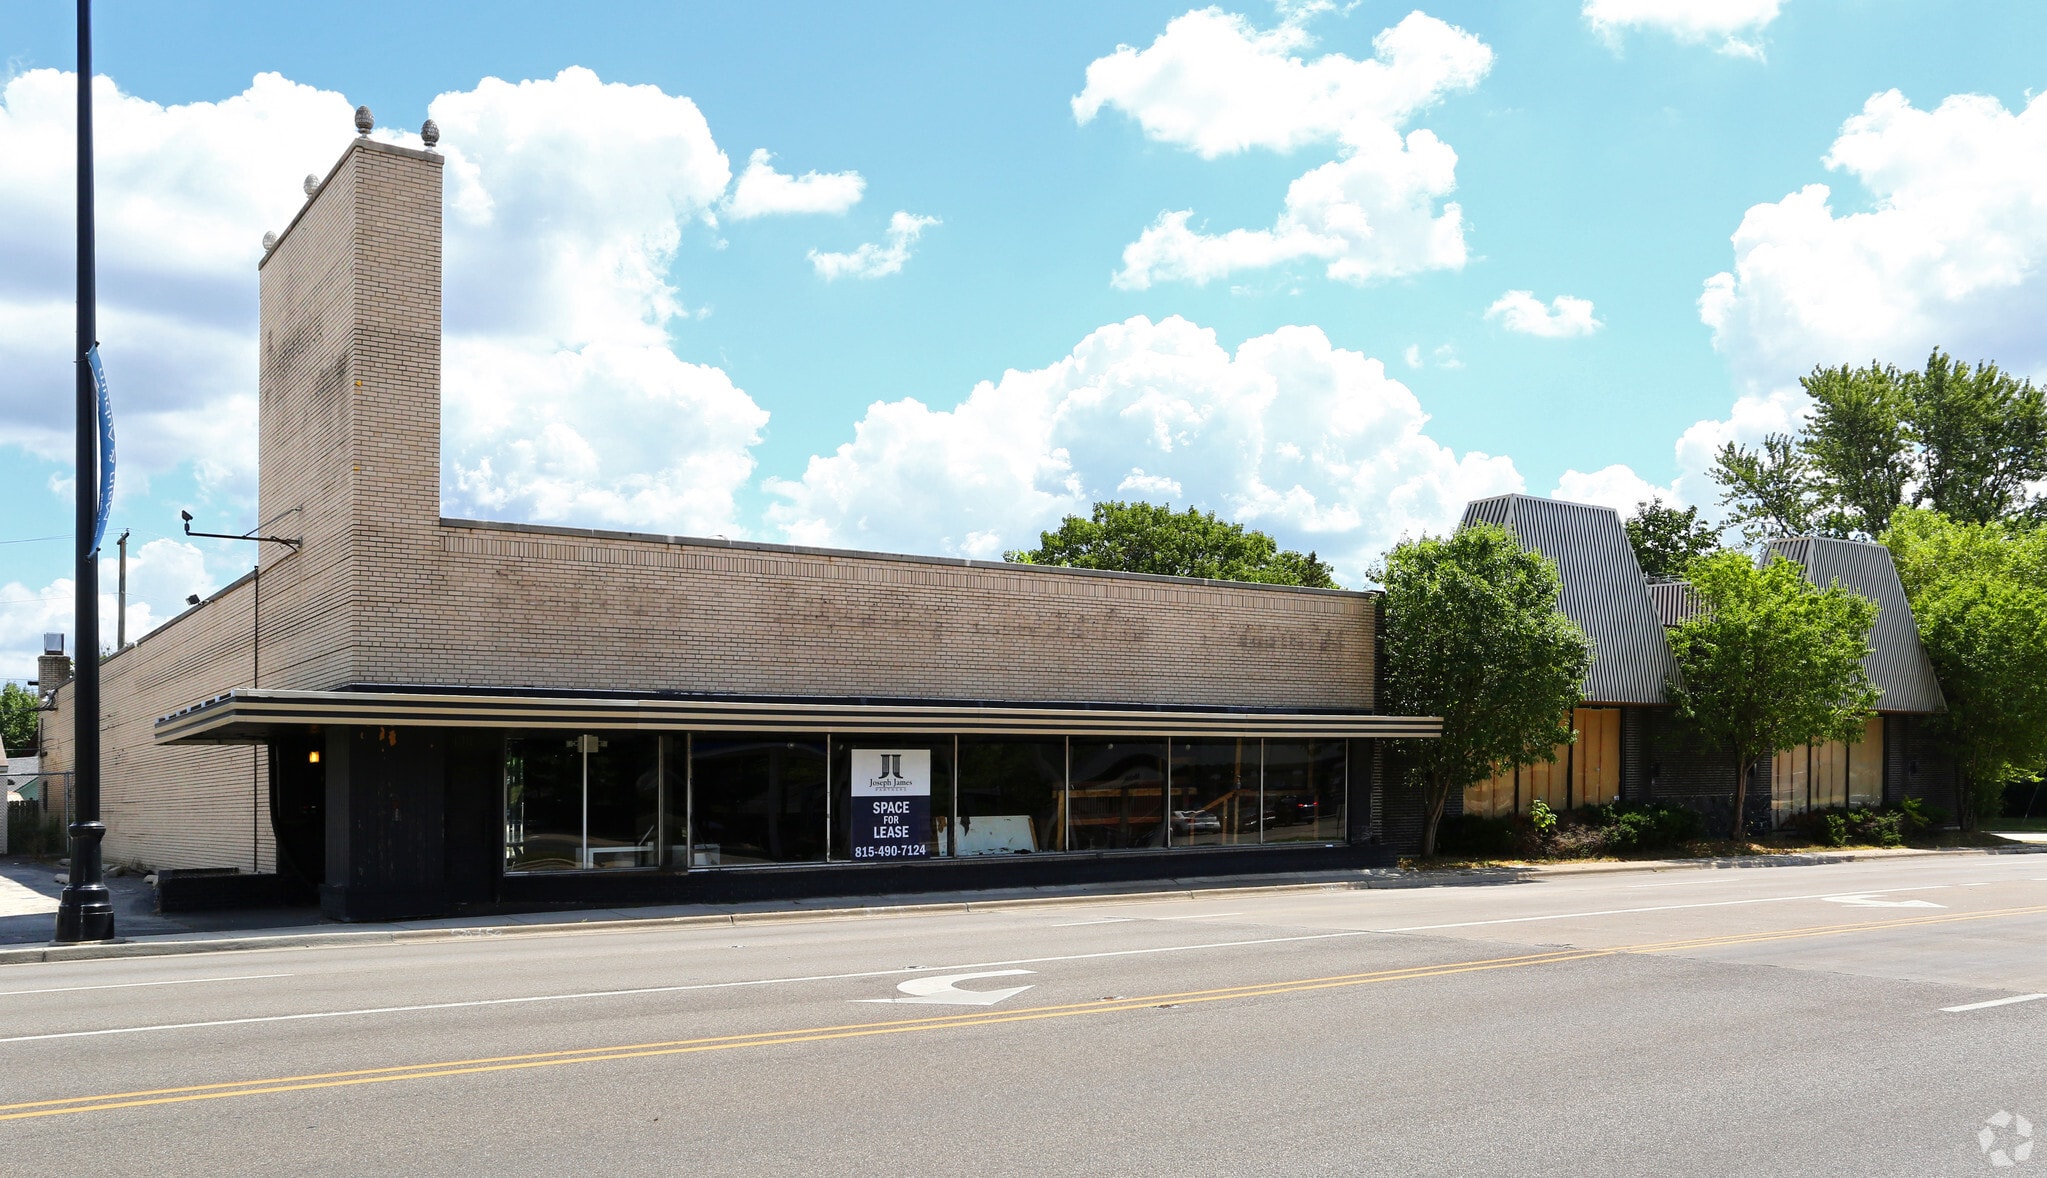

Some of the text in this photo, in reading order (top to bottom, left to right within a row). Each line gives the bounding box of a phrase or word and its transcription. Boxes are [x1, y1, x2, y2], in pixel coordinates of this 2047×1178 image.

[98, 367, 116, 441] Auburn
[103, 471, 115, 521] Main
[869, 778, 913, 787] Joseph James
[872, 801, 910, 814] SPACE
[883, 815, 899, 824] FOR
[873, 826, 910, 839] LEASE
[855, 844, 926, 858] 815-490-7124
